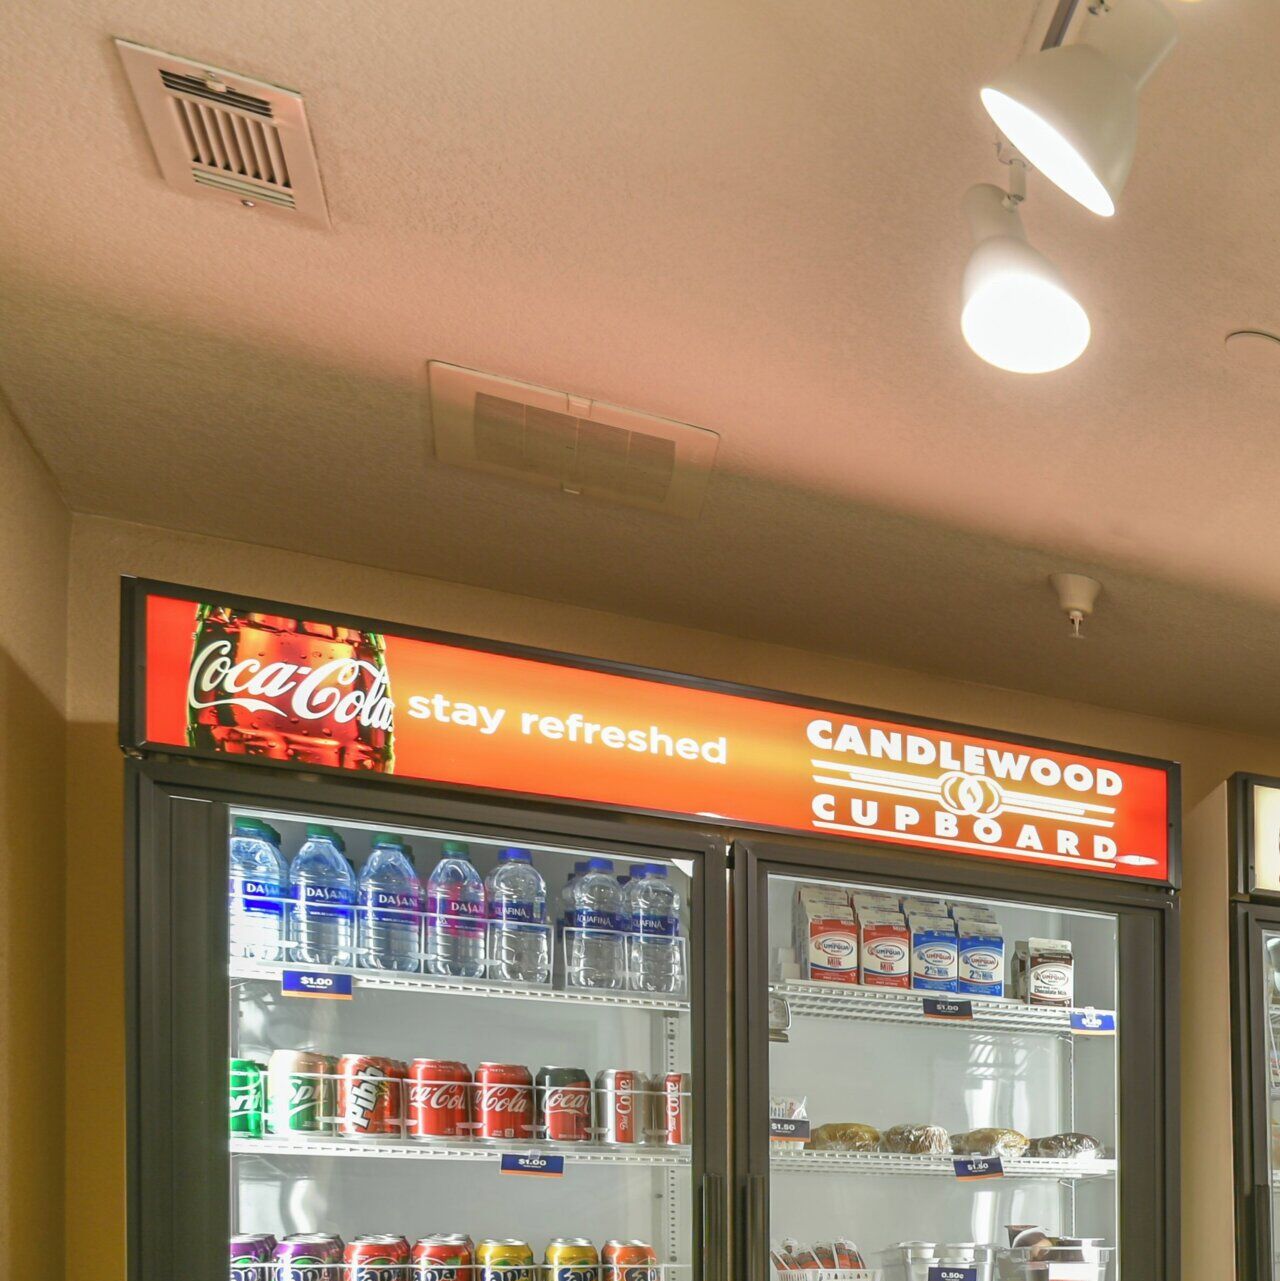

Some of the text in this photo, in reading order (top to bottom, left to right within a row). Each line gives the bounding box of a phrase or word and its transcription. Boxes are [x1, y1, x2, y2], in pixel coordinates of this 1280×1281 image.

[189, 640, 395, 732] Coca-Cola
[408, 693, 727, 764] stay refreshed
[807, 720, 1123, 796] CANDLEWOOD
[812, 794, 1118, 860] CUPBOARD
[300, 976, 333, 986] $1.00
[518, 1158, 547, 1167] $1.00
